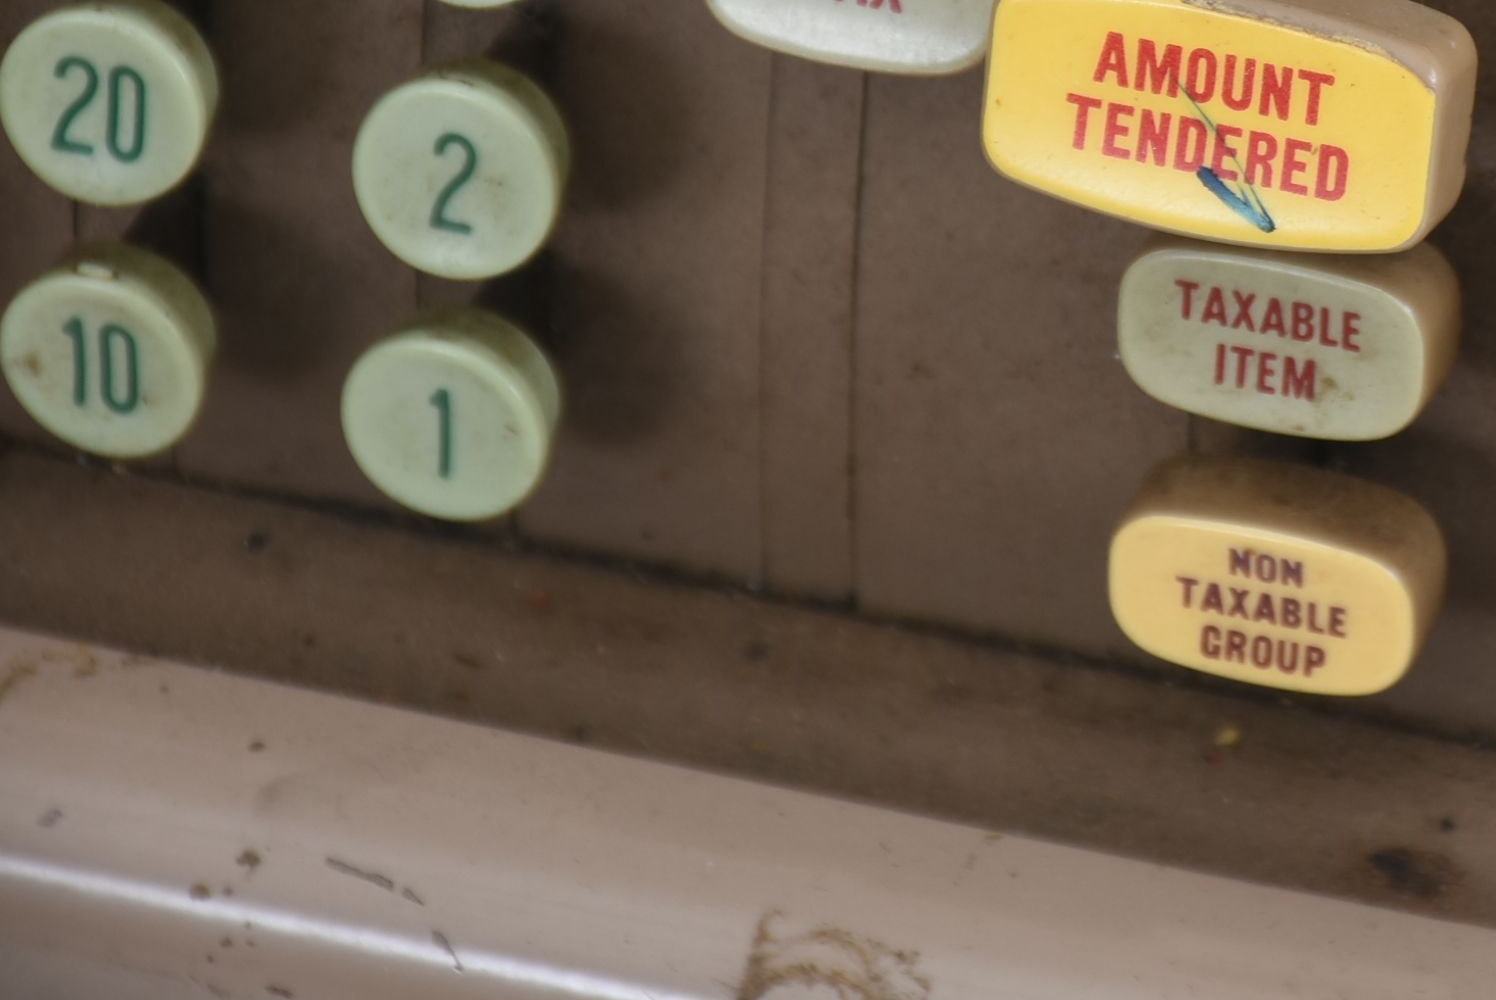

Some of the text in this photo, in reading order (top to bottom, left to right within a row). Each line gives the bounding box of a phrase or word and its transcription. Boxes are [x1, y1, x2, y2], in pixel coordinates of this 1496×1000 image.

[50, 55, 147, 164] 20
[1093, 31, 1336, 127] AMOUNT
[428, 132, 478, 236] 2
[1065, 91, 1350, 202] TENDERED
[1174, 279, 1362, 353] TAXABLE
[61, 316, 141, 415] 10
[1214, 343, 1319, 401] ITEM
[427, 388, 454, 480] 1
[1175, 575, 1348, 640] TAXABLE
[1228, 548, 1304, 589] NON
[1200, 626, 1328, 678] GROUP
